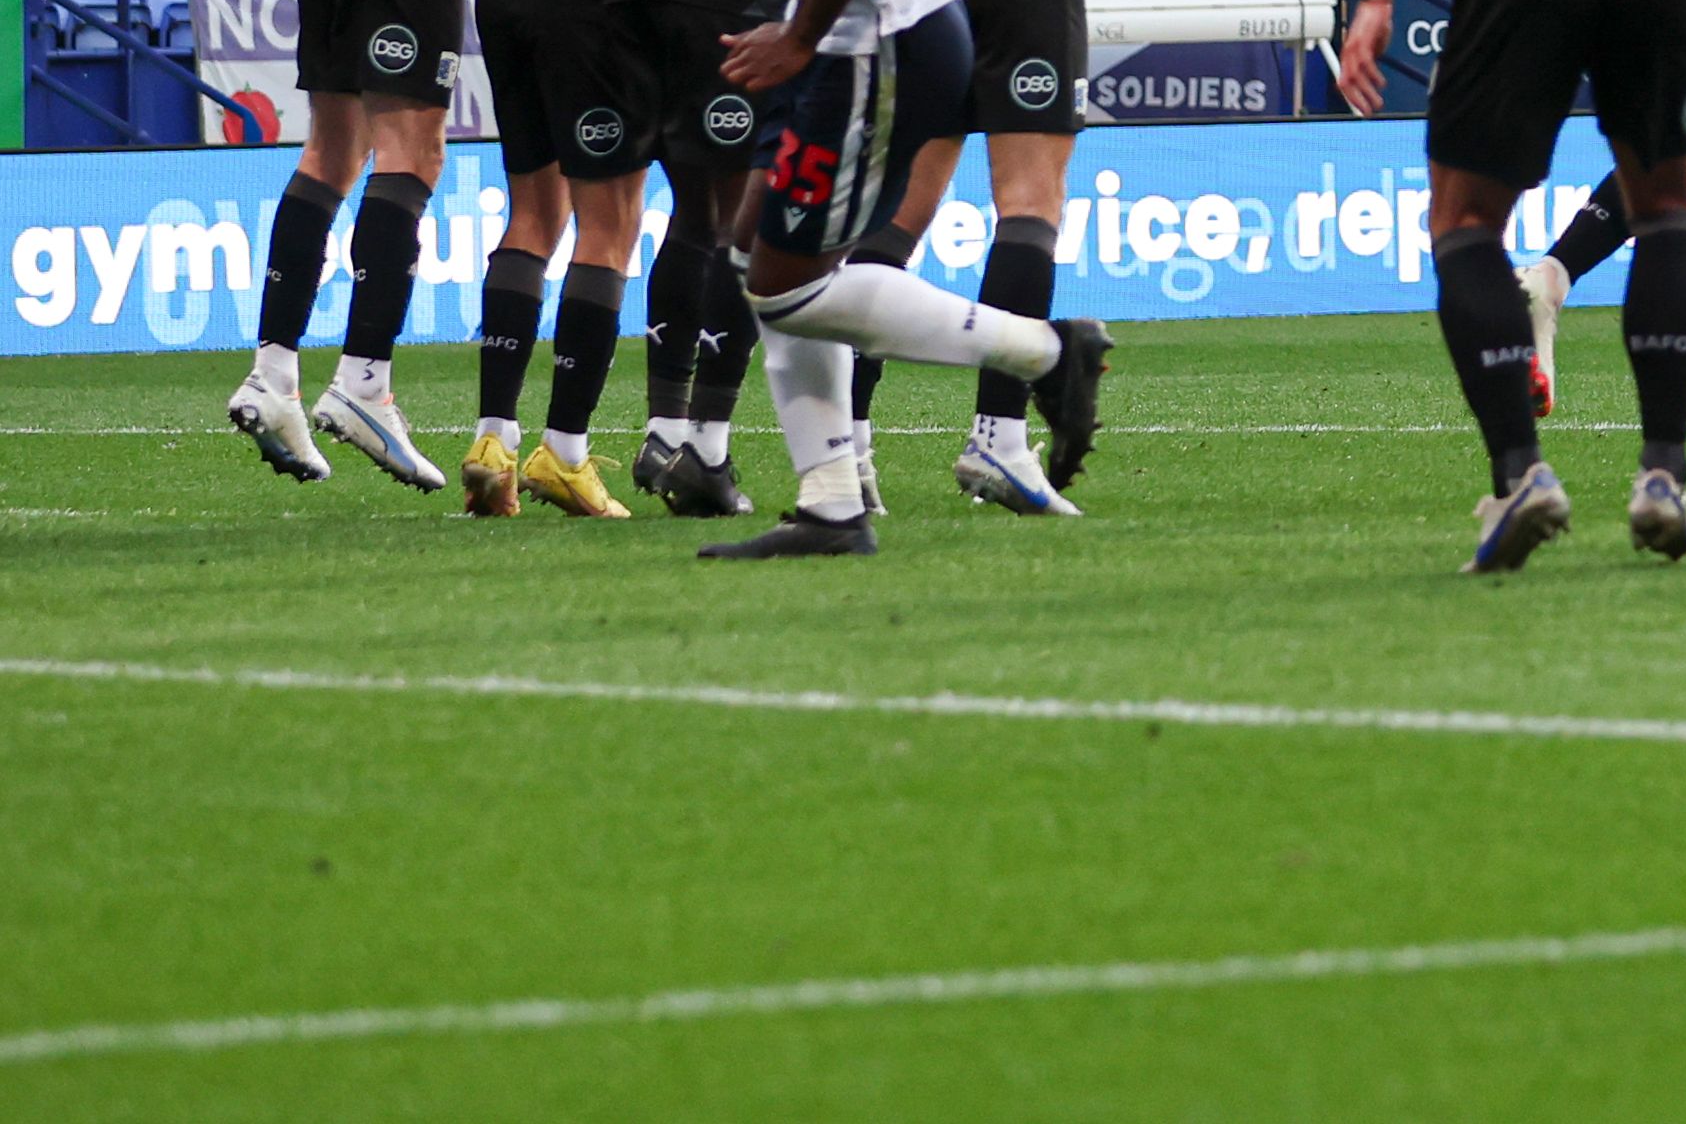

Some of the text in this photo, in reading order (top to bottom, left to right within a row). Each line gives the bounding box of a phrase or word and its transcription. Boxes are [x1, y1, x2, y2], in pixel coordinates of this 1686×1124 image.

[374, 38, 415, 60] DSG
[1016, 75, 1056, 93] DSG
[1097, 75, 1267, 113] SOLDIERS
[710, 111, 750, 129] DSG
[581, 122, 621, 141] DSG
[766, 128, 840, 205] 35
[11, 221, 252, 327] gym
